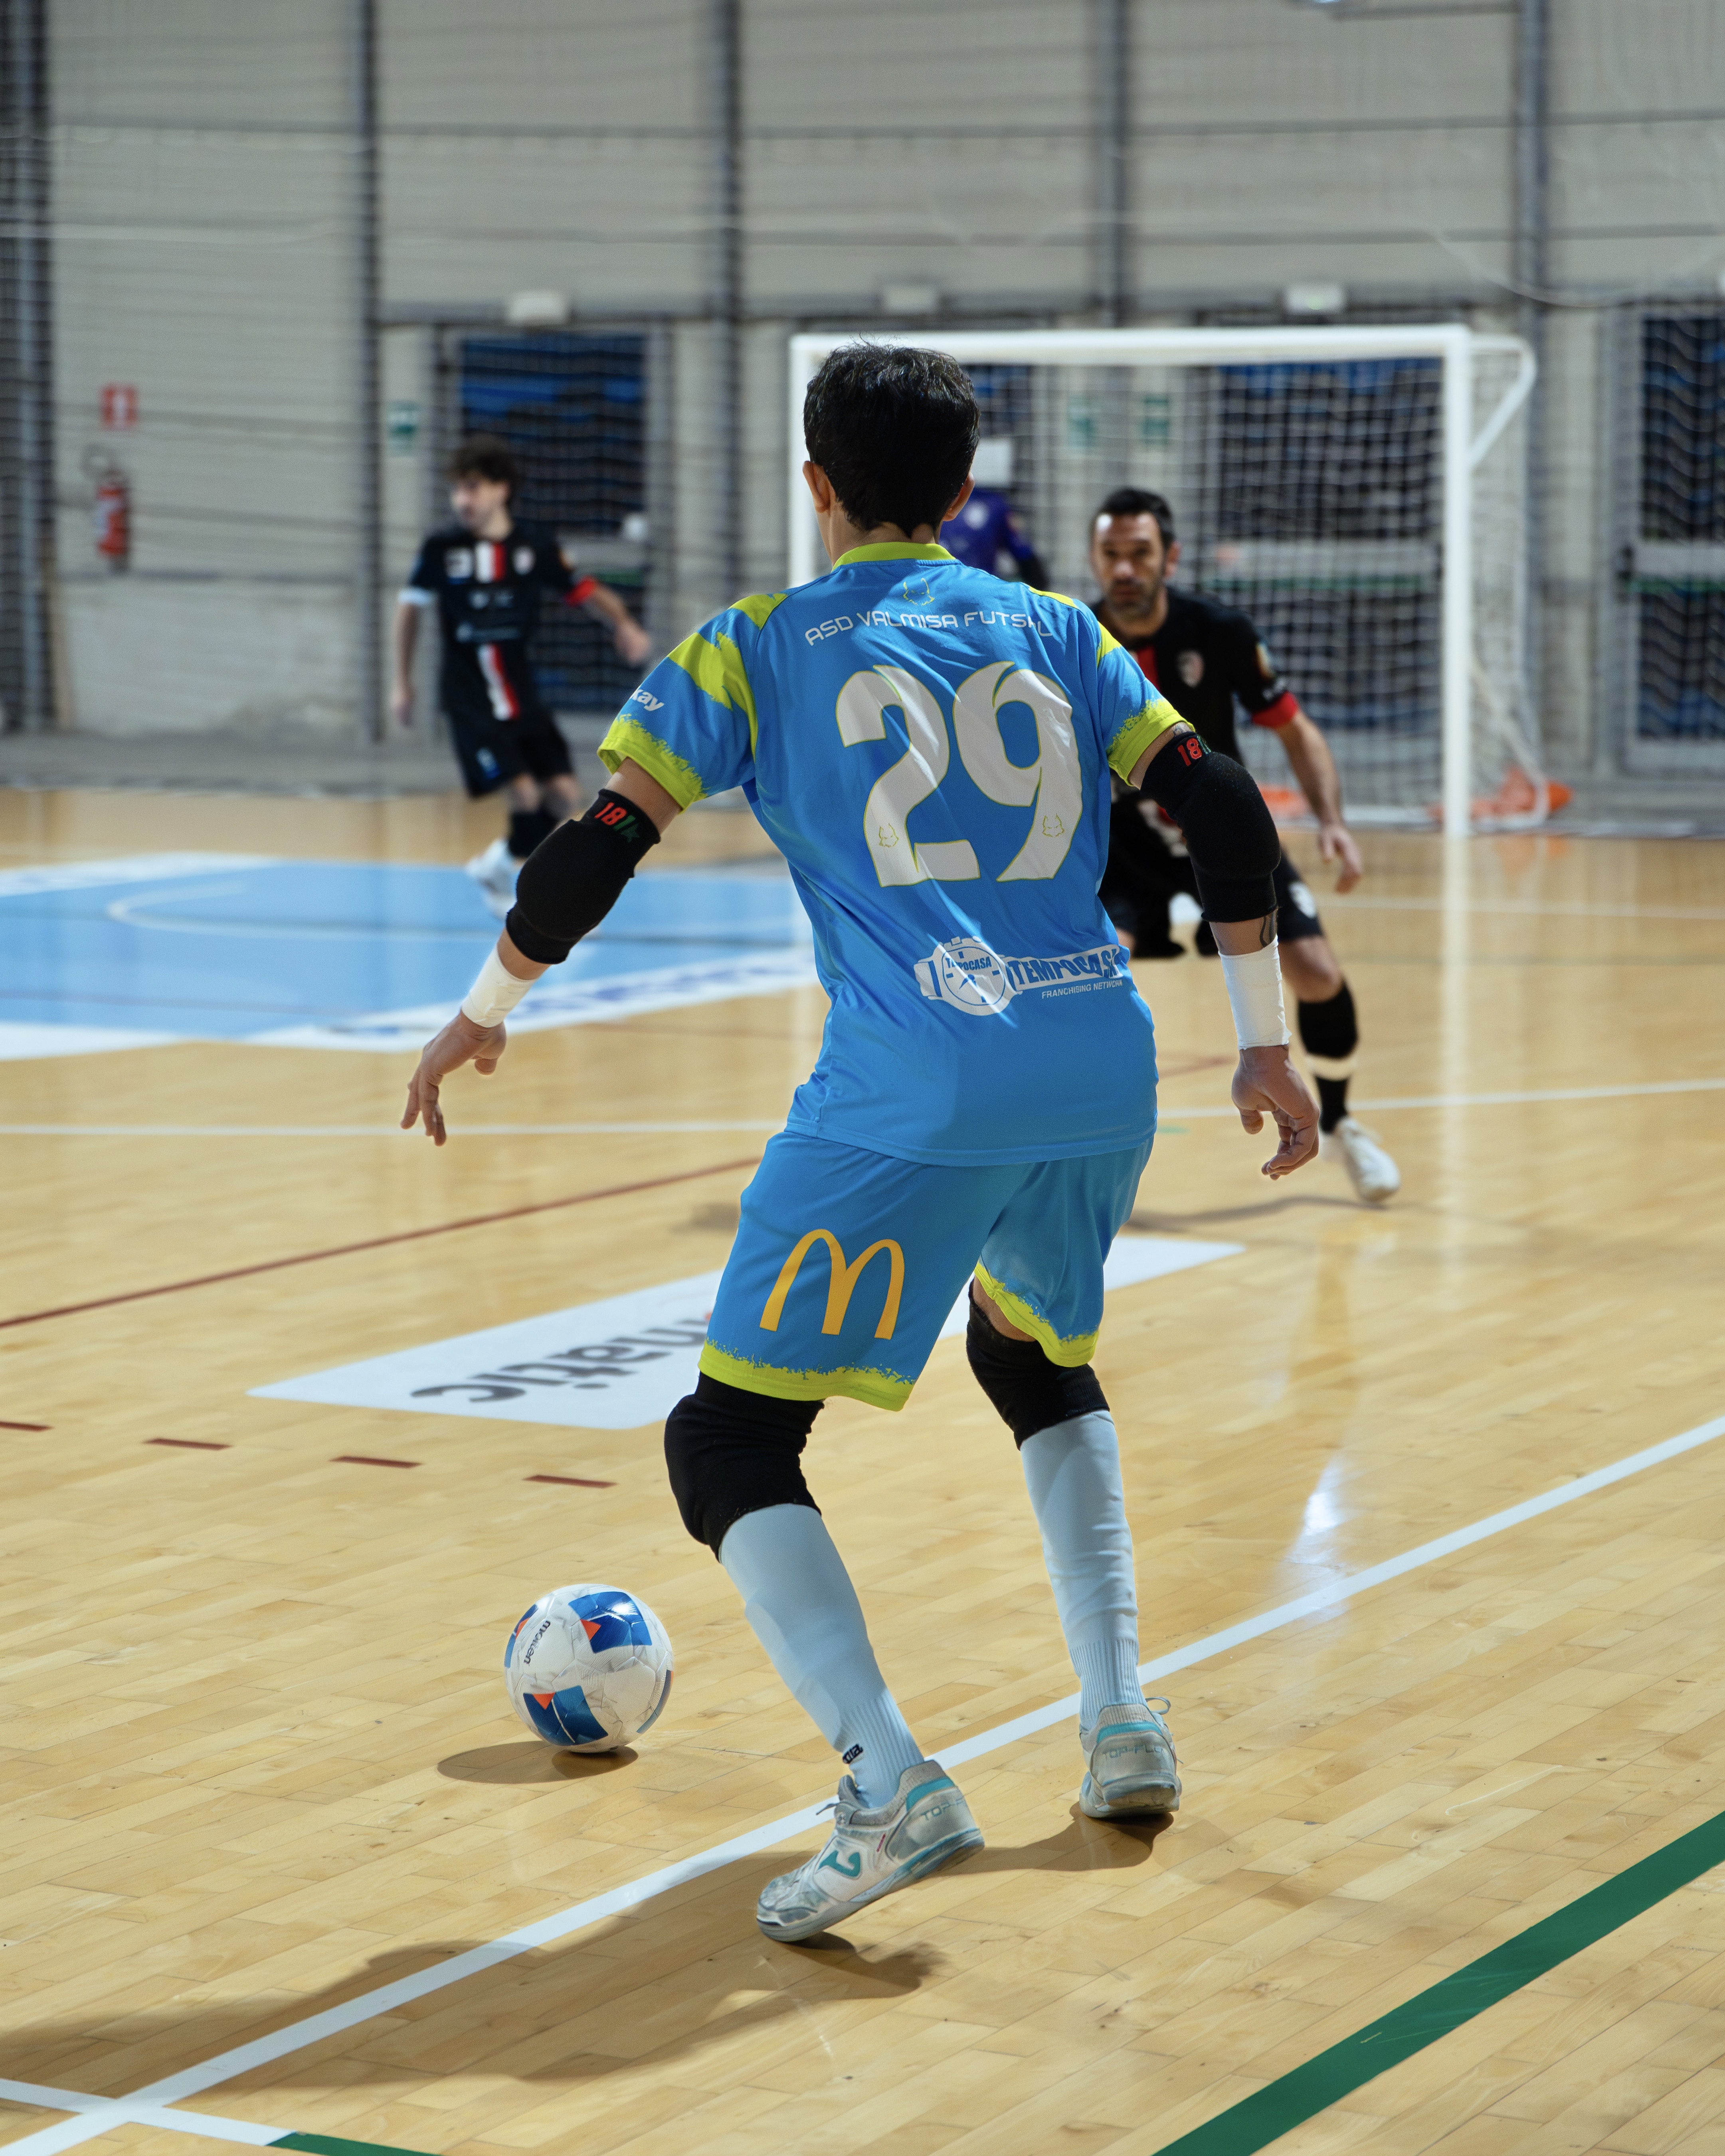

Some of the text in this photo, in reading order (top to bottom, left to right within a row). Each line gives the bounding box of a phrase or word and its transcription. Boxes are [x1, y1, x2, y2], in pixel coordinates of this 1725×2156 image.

[805, 615, 853, 646] ASD
[856, 610, 959, 628] VALMISA
[835, 661, 1083, 887] 29
[1042, 984, 1092, 999] FRANCHISING
[524, 1620, 551, 1664] molten
